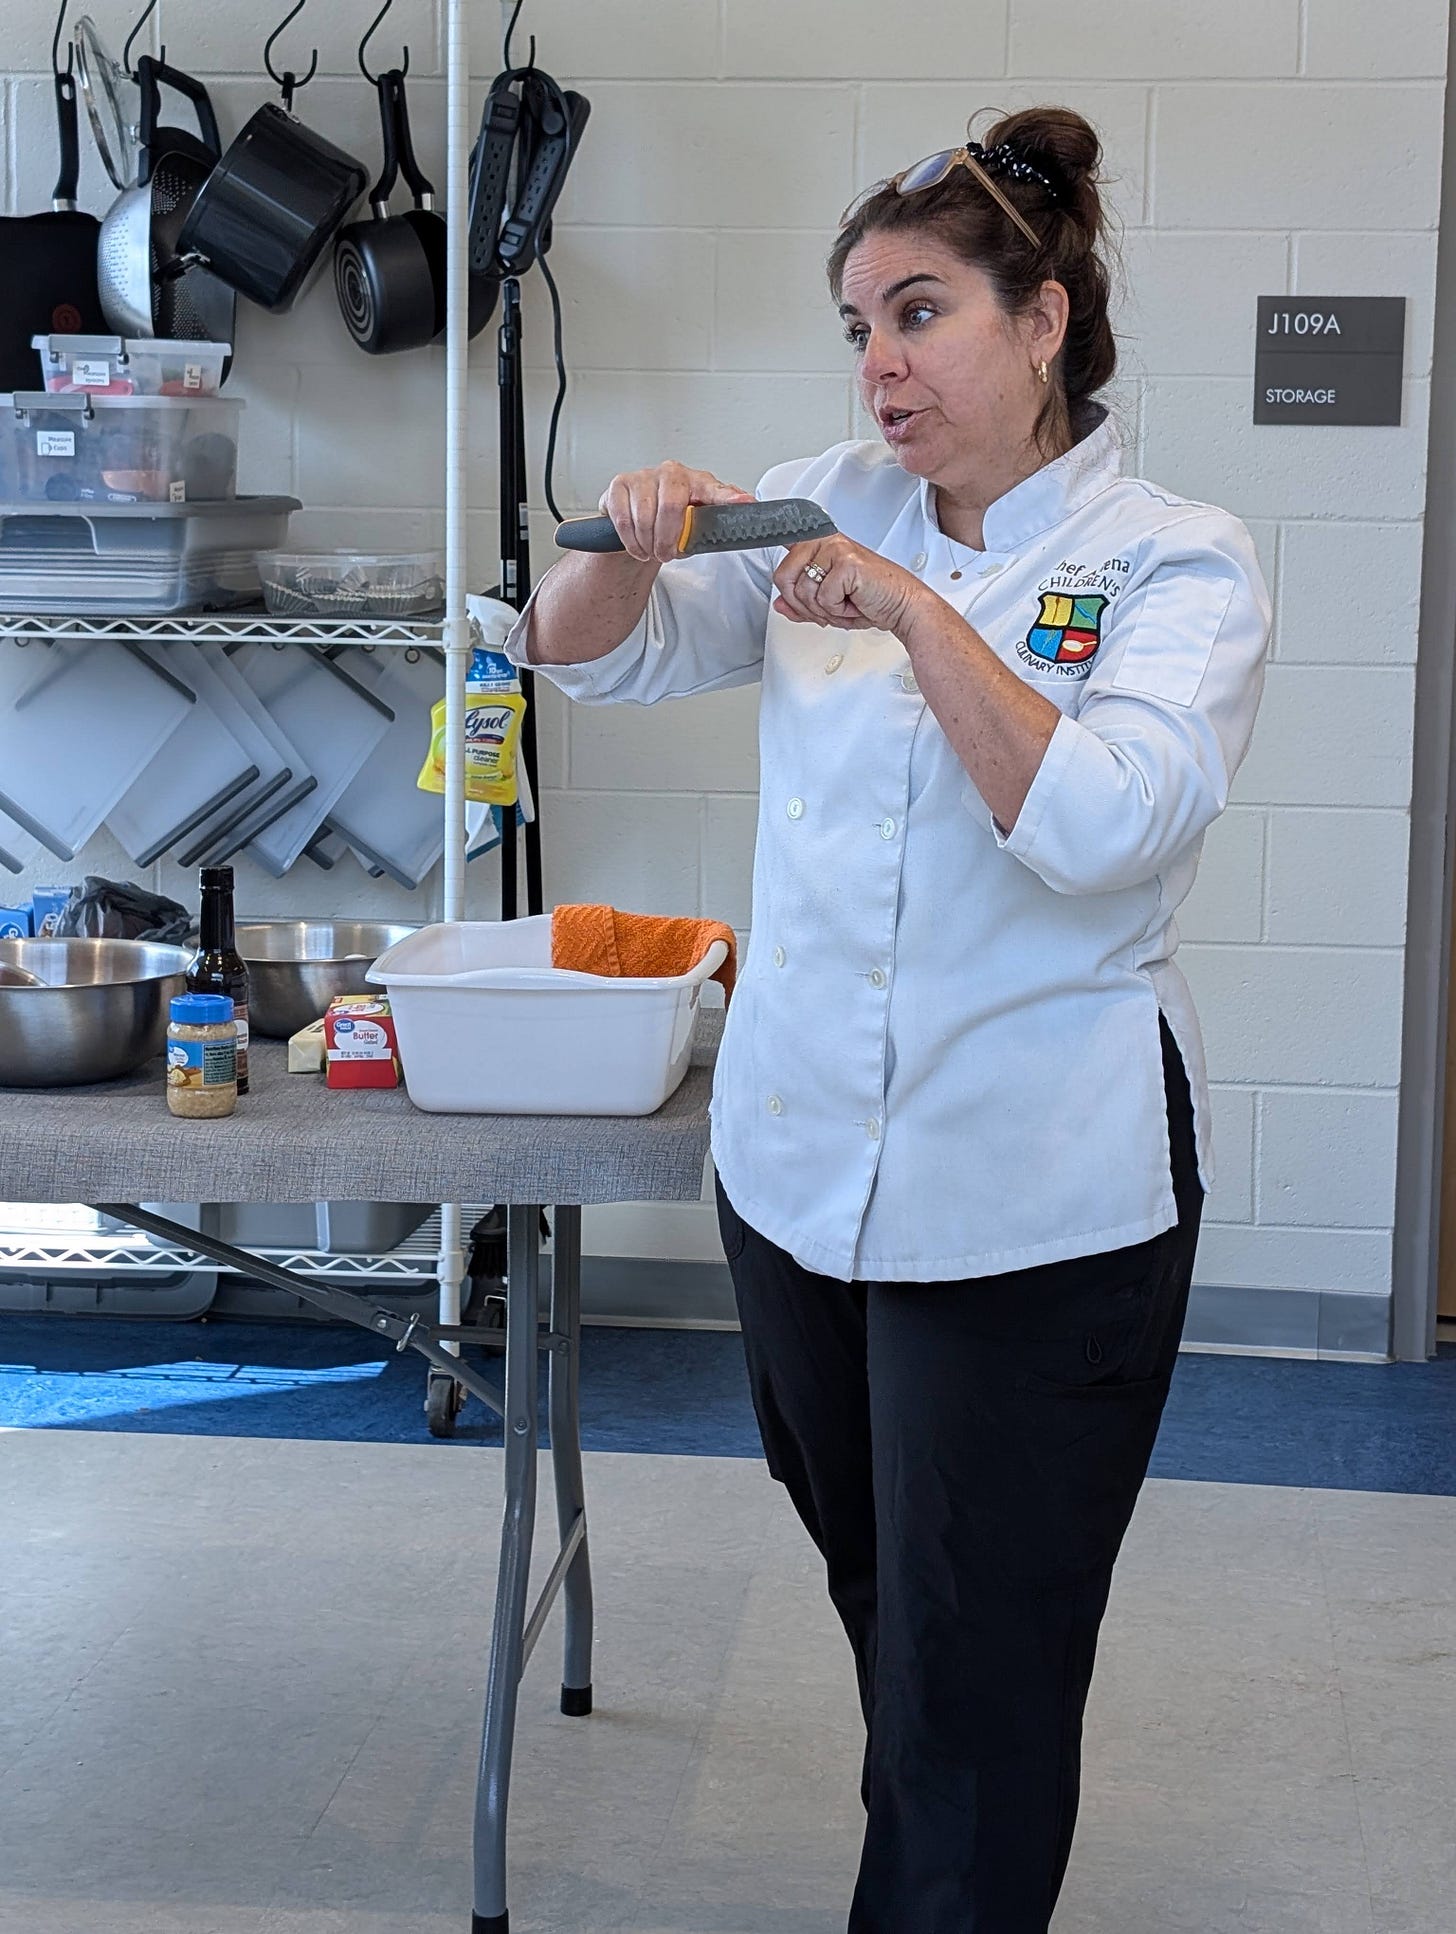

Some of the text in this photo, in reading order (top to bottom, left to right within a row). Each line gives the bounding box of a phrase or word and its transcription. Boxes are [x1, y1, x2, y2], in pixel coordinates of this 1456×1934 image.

[1268, 313, 1341, 335] J109A
[1265, 388, 1336, 404] STORAGE
[1054, 560, 1087, 576] hef
[1038, 575, 1121, 597] CHILDREN'S
[1015, 641, 1055, 673] CULINARY
[465, 710, 509, 736] Lysol
[353, 1032, 379, 1041] Butter
